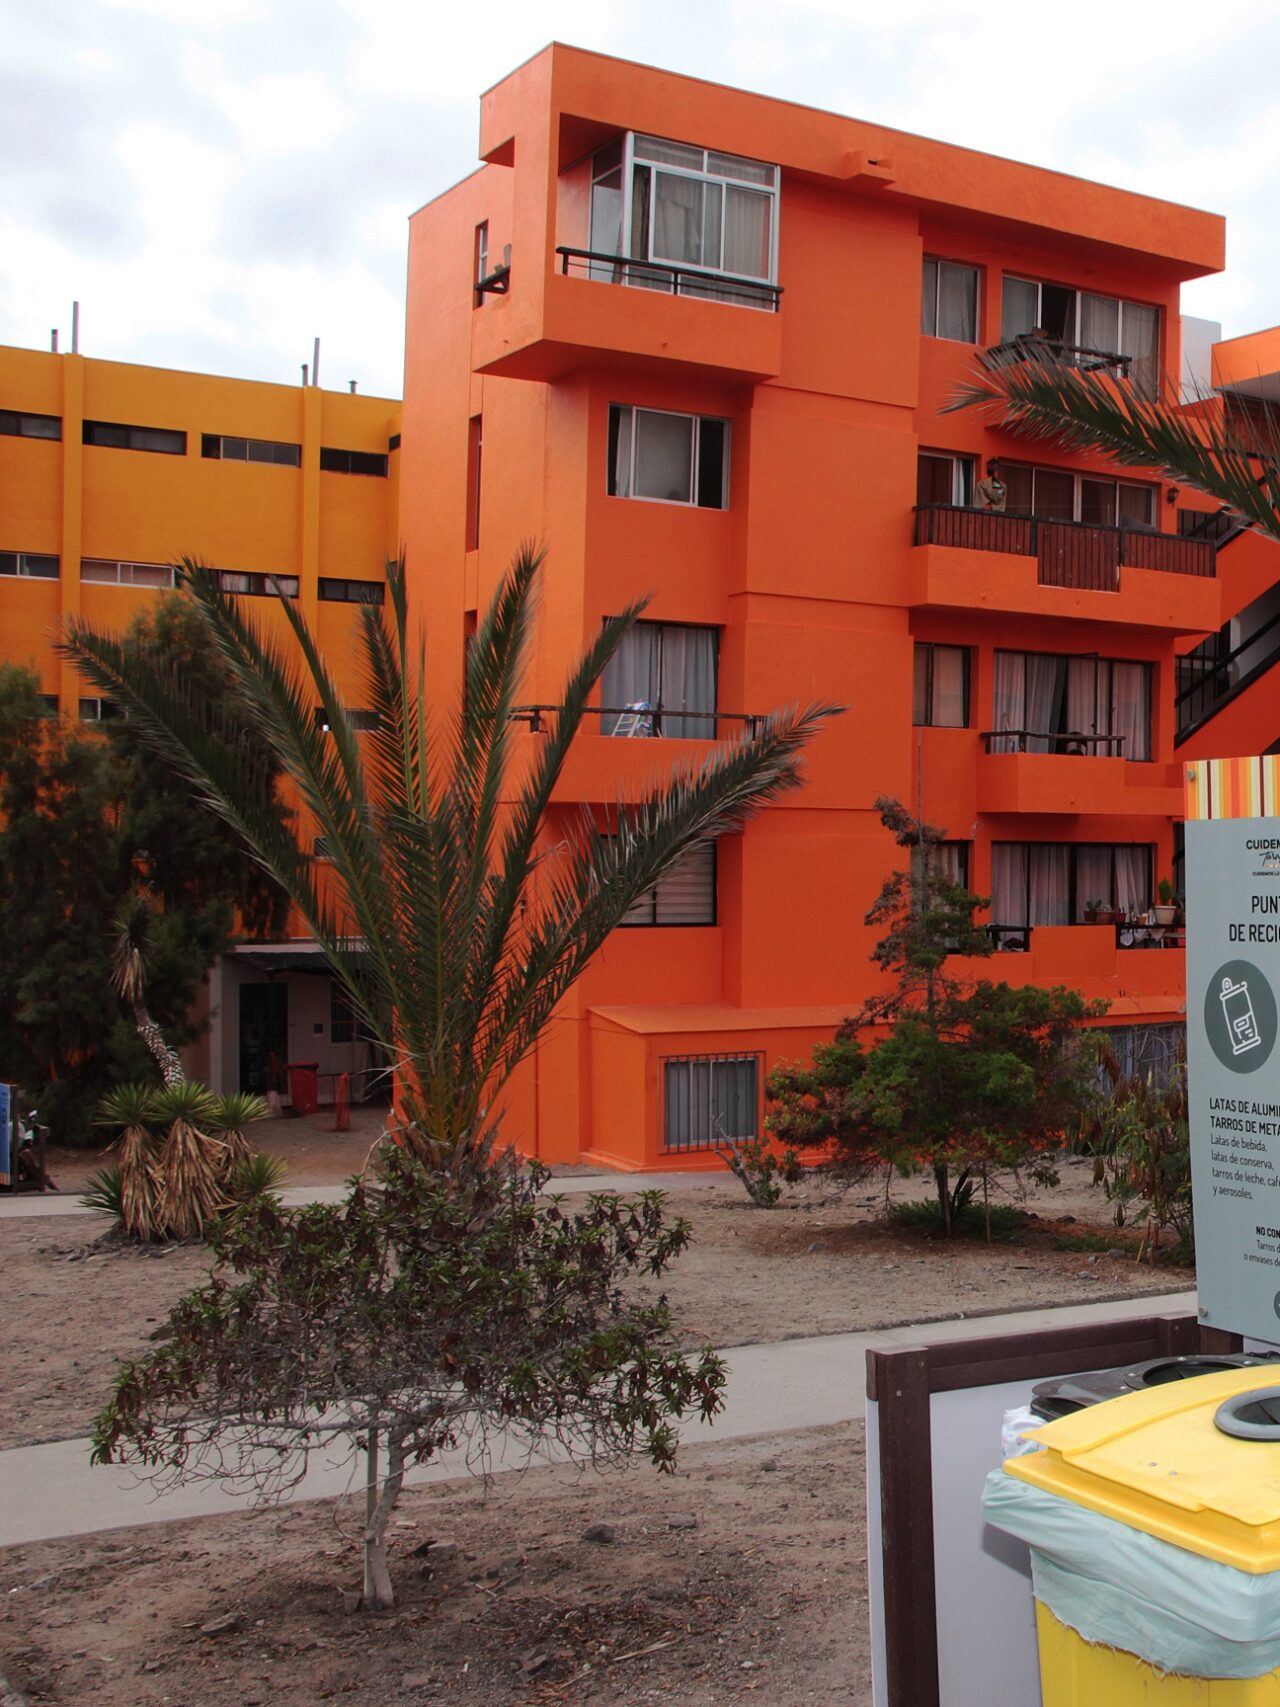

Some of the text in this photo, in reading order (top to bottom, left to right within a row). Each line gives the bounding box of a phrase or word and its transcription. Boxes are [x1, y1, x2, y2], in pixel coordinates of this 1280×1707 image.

[1229, 924, 1245, 942] DE
[1209, 1097, 1237, 1112] LATAS
[1238, 1100, 1250, 1114] DE
[1210, 1115, 1244, 1132] TARROS
[1245, 1120, 1257, 1133] DE
[1210, 1133, 1230, 1147] Latas
[1231, 1136, 1240, 1148] de
[1211, 1149, 1228, 1163] latas
[1229, 1152, 1239, 1165] de
[1212, 1167, 1233, 1180] tarros
[1234, 1170, 1244, 1181] de
[1212, 1186, 1218, 1197] y
[1256, 1225, 1265, 1236] NO
[1256, 1239, 1276, 1253] Tarros
[1243, 1253, 1248, 1261] o
[1248, 1254, 1273, 1266] envases
